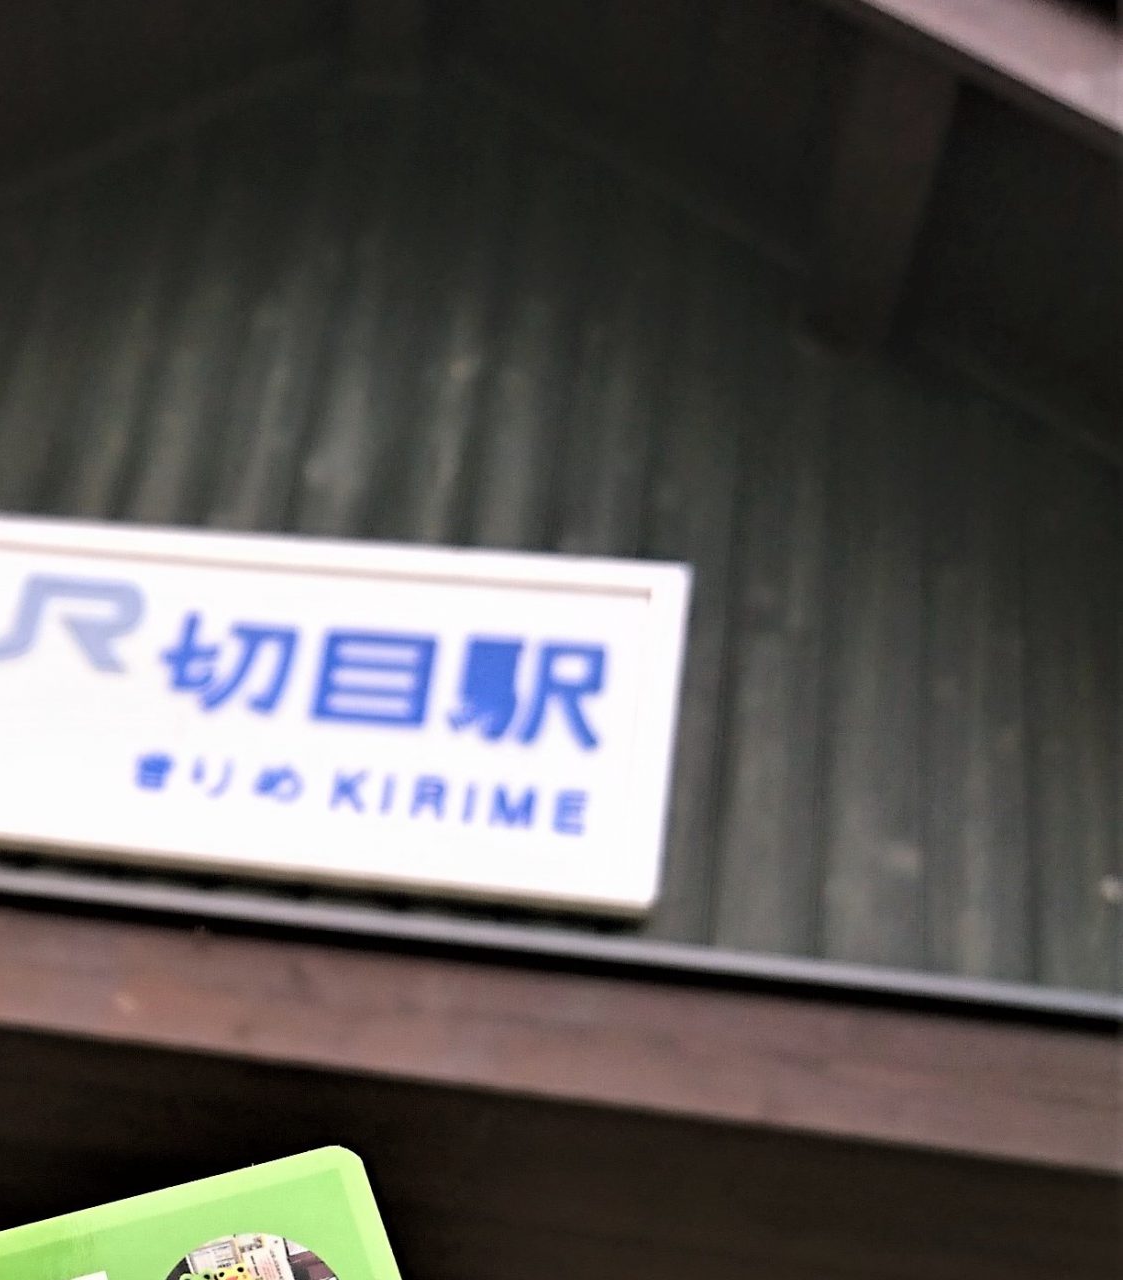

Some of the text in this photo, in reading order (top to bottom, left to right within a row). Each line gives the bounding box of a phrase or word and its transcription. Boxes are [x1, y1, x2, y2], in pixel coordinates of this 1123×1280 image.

[160, 612, 609, 752] 切目駅
[134, 750, 589, 838] きりめ KIRIME
